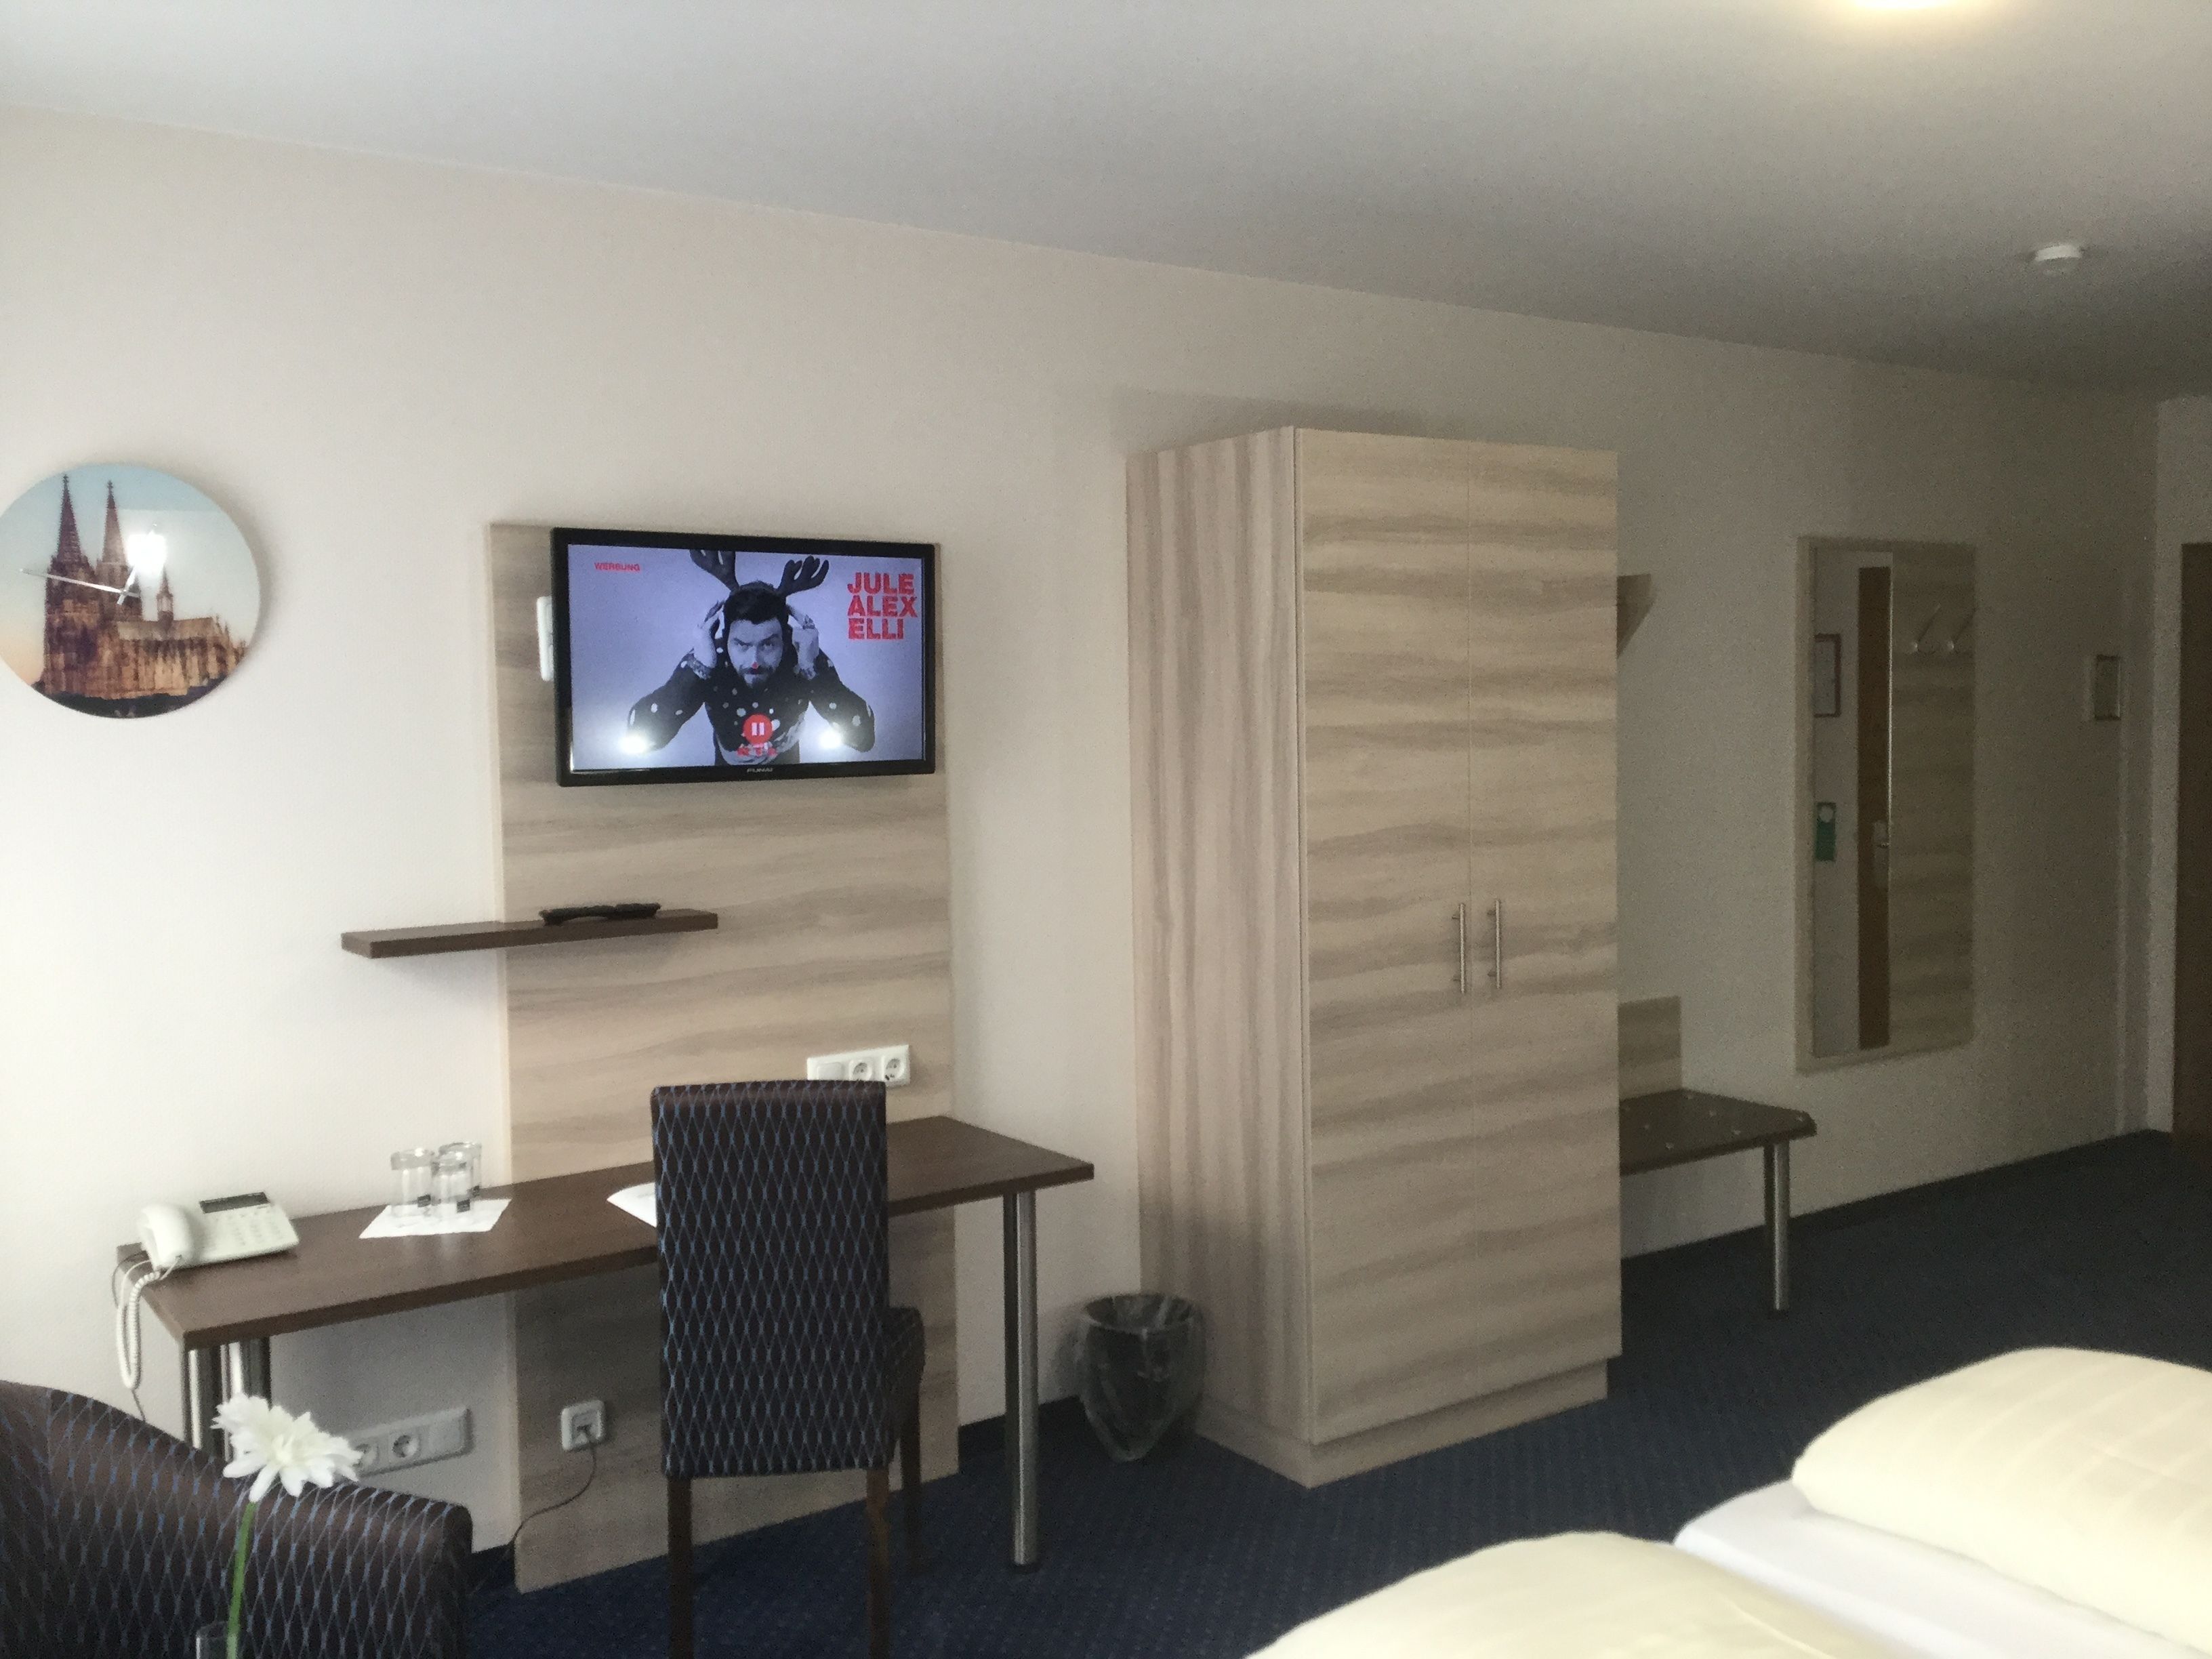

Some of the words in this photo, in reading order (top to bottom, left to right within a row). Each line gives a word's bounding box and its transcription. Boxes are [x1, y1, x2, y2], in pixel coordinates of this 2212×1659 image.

[594, 562, 640, 571] WERBUNG
[847, 572, 914, 594] JULE
[847, 595, 918, 617] ALEX
[848, 617, 903, 639] ELLI
